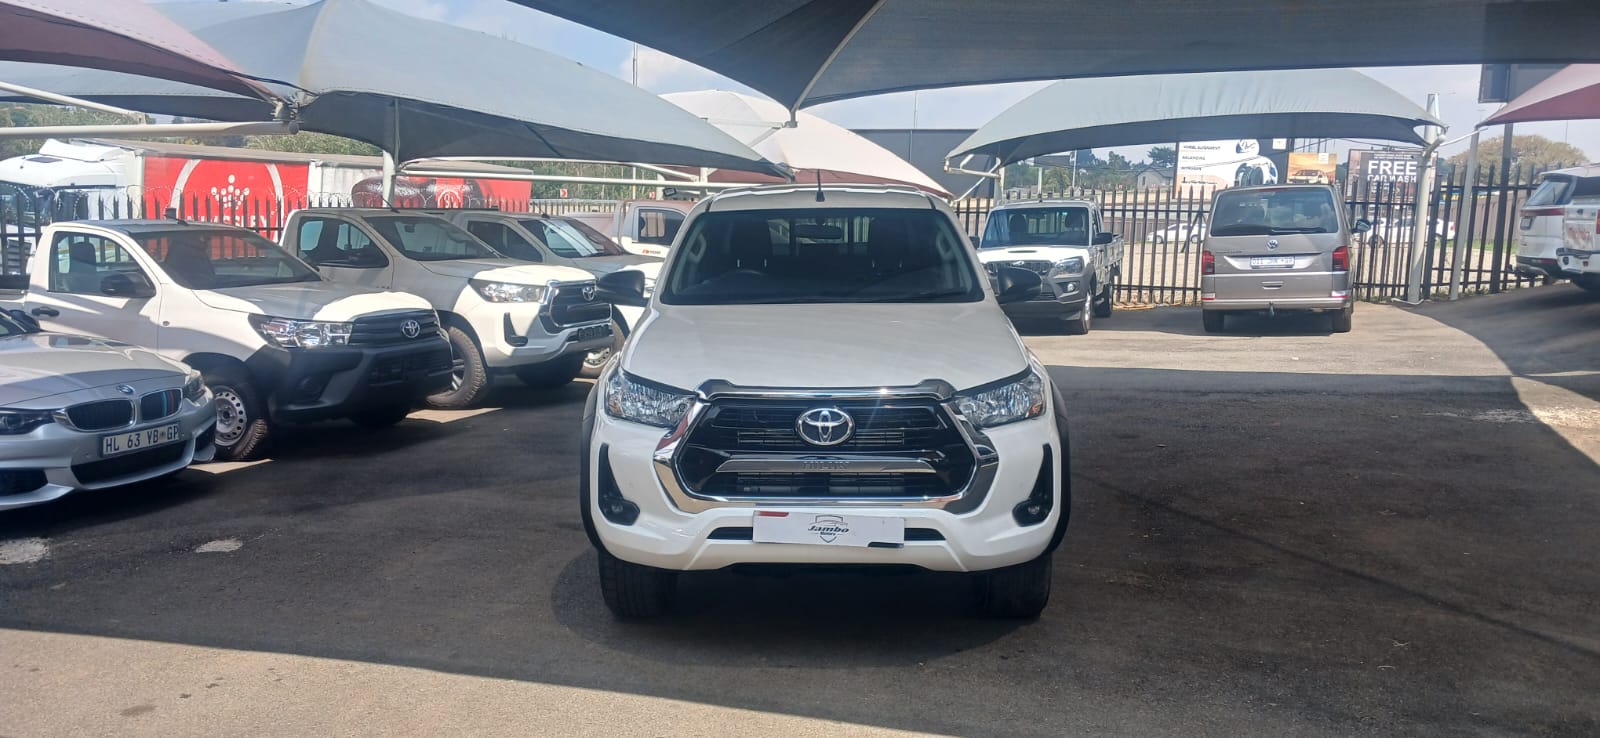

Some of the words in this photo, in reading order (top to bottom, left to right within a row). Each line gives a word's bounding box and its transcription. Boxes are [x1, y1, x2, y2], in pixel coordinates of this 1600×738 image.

[1367, 160, 1418, 176] FREE
[1389, 175, 1417, 184] WASH
[105, 438, 119, 452] HL
[127, 434, 140, 448] 63
[166, 426, 178, 440] GP
[808, 525, 849, 533] Jambo
